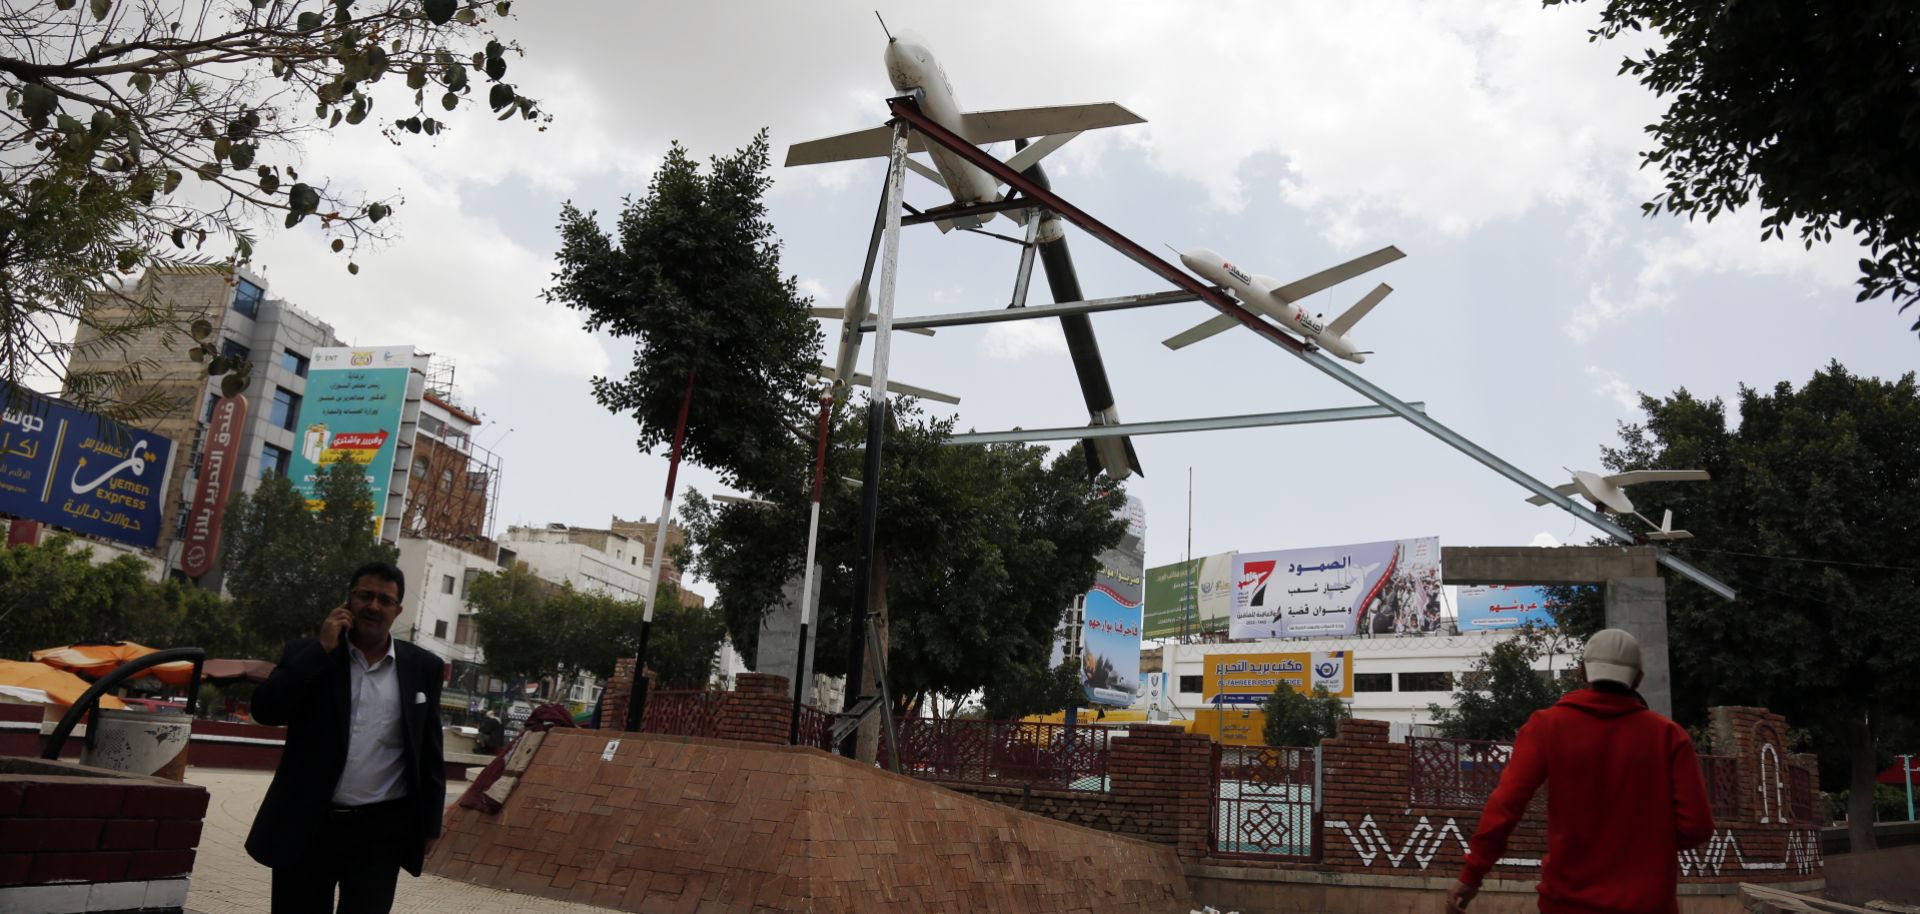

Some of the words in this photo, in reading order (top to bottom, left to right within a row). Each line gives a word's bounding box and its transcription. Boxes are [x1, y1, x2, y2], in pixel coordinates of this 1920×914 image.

[213, 401, 235, 447] فندق
[205, 450, 225, 504] التحرير
[63, 498, 101, 520] مالية
[192, 508, 215, 540] بلازا
[1288, 555, 1351, 576] الصمود
[1287, 582, 1319, 597] شعب
[1322, 582, 1352, 594] خيار
[1287, 604, 1309, 618] قضية
[1312, 604, 1352, 617] وعنوان
[1489, 600, 1537, 613] عروشهم
[1250, 661, 1270, 674] بريد
[1272, 659, 1302, 674] مكتب
